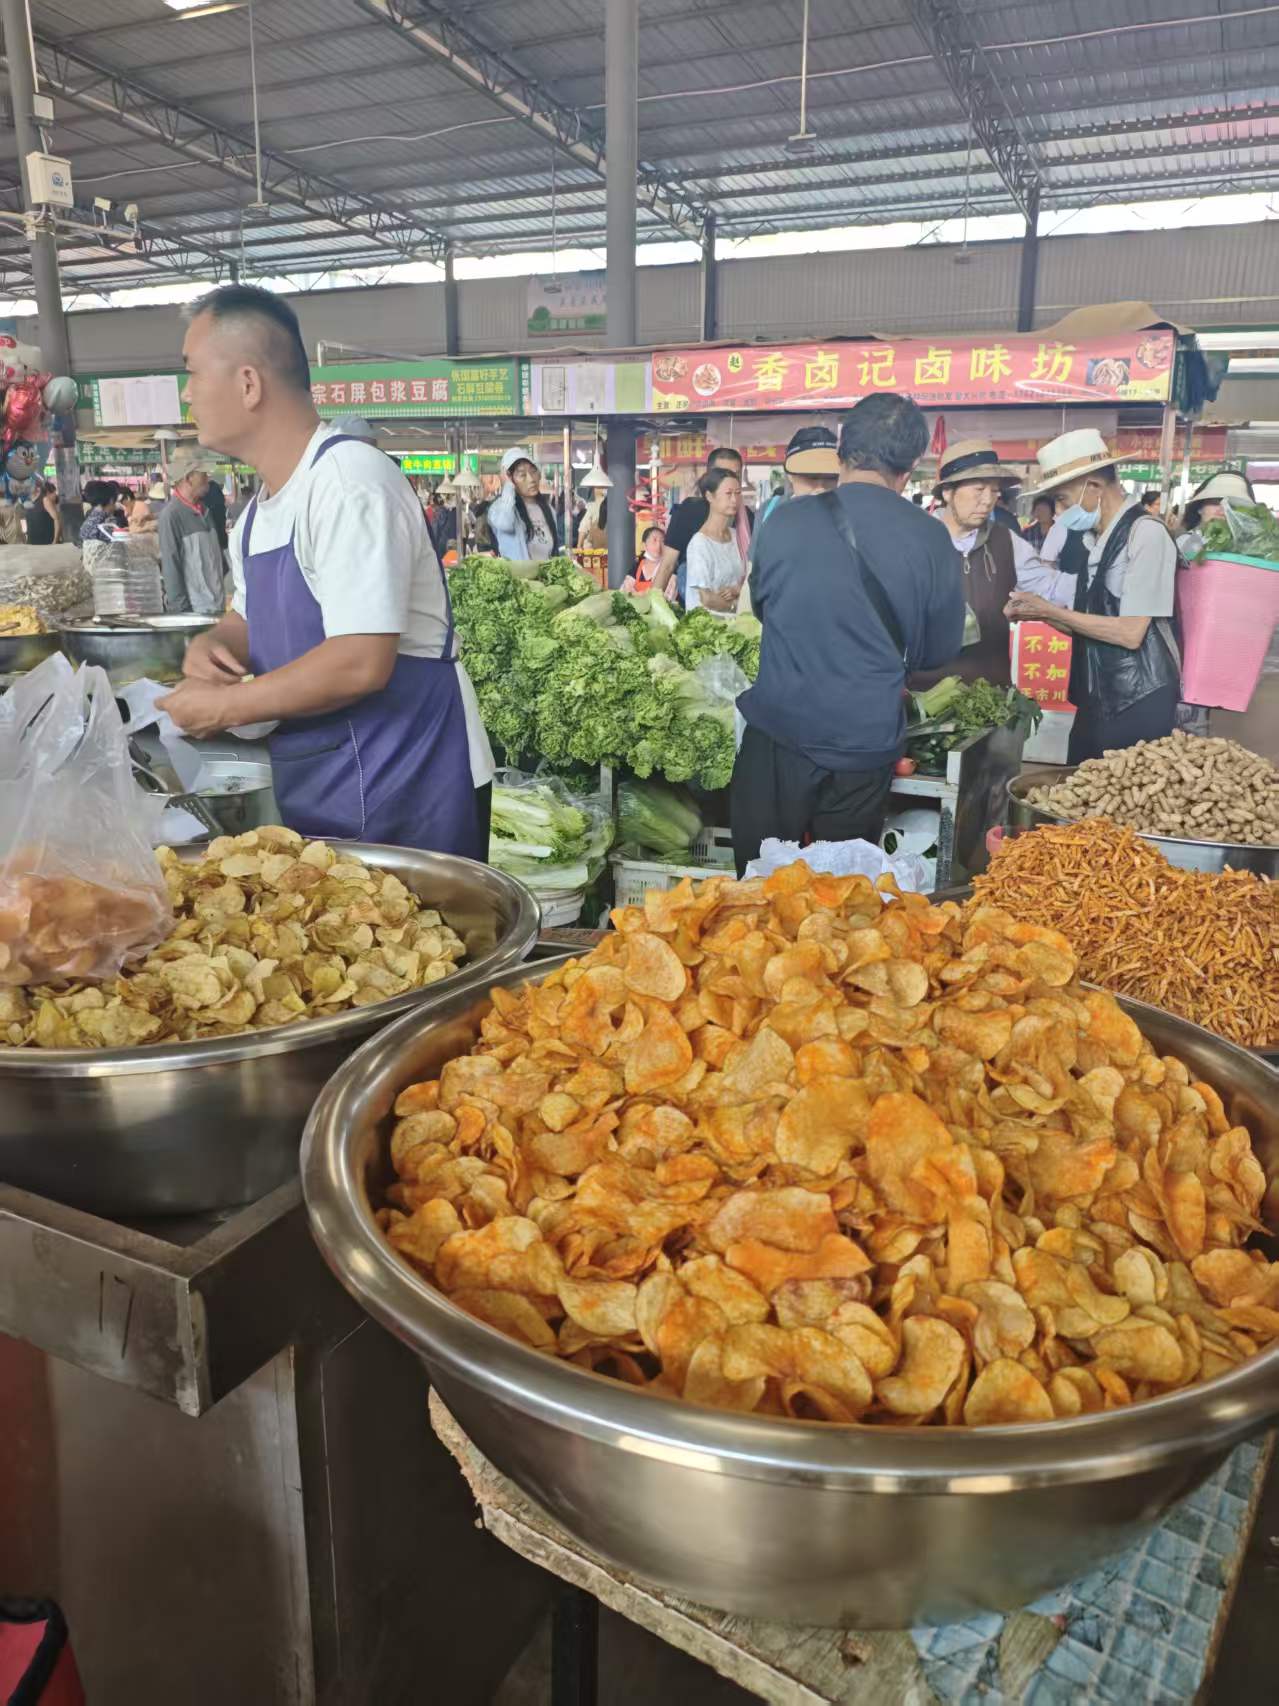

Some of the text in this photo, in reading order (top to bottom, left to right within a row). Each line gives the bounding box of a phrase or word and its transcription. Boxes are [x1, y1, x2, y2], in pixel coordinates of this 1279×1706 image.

[751, 343, 1076, 391] 香卤记卤味坊
[1023, 635, 1069, 653] 不加
[1023, 663, 1067, 680] 不加
